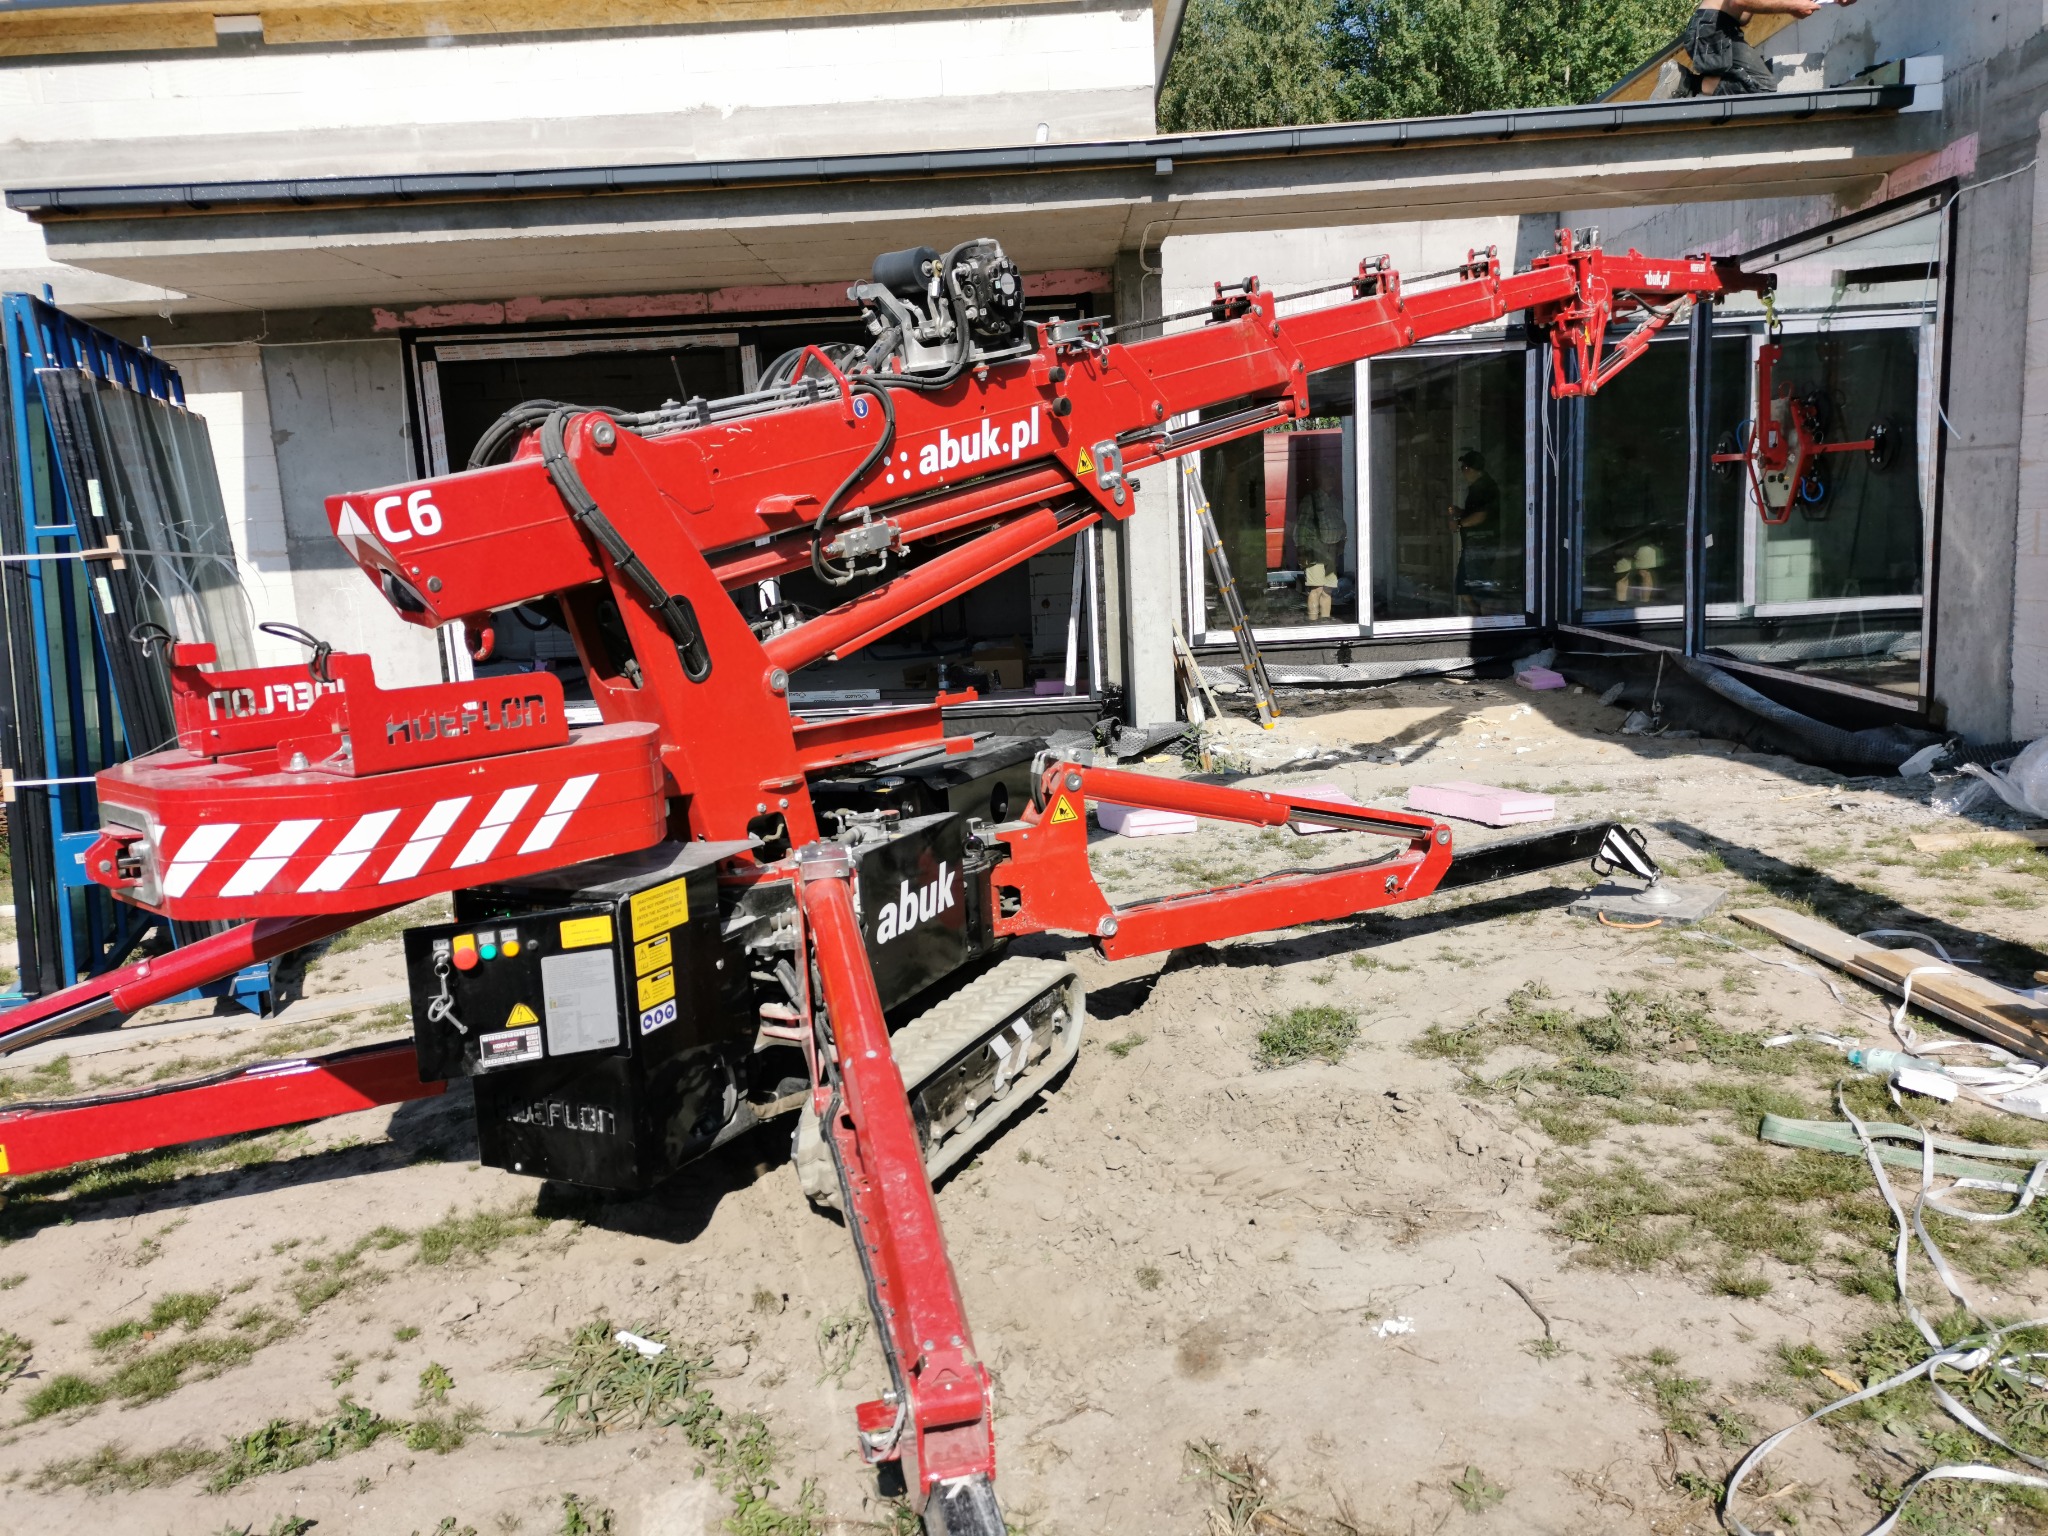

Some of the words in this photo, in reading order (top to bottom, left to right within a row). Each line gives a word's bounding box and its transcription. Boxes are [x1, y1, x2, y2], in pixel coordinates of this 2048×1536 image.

[918, 406, 1039, 476] abuk.pl
[373, 489, 442, 543] C6
[386, 694, 547, 746] HOEFLON
[876, 861, 956, 945] abuk
